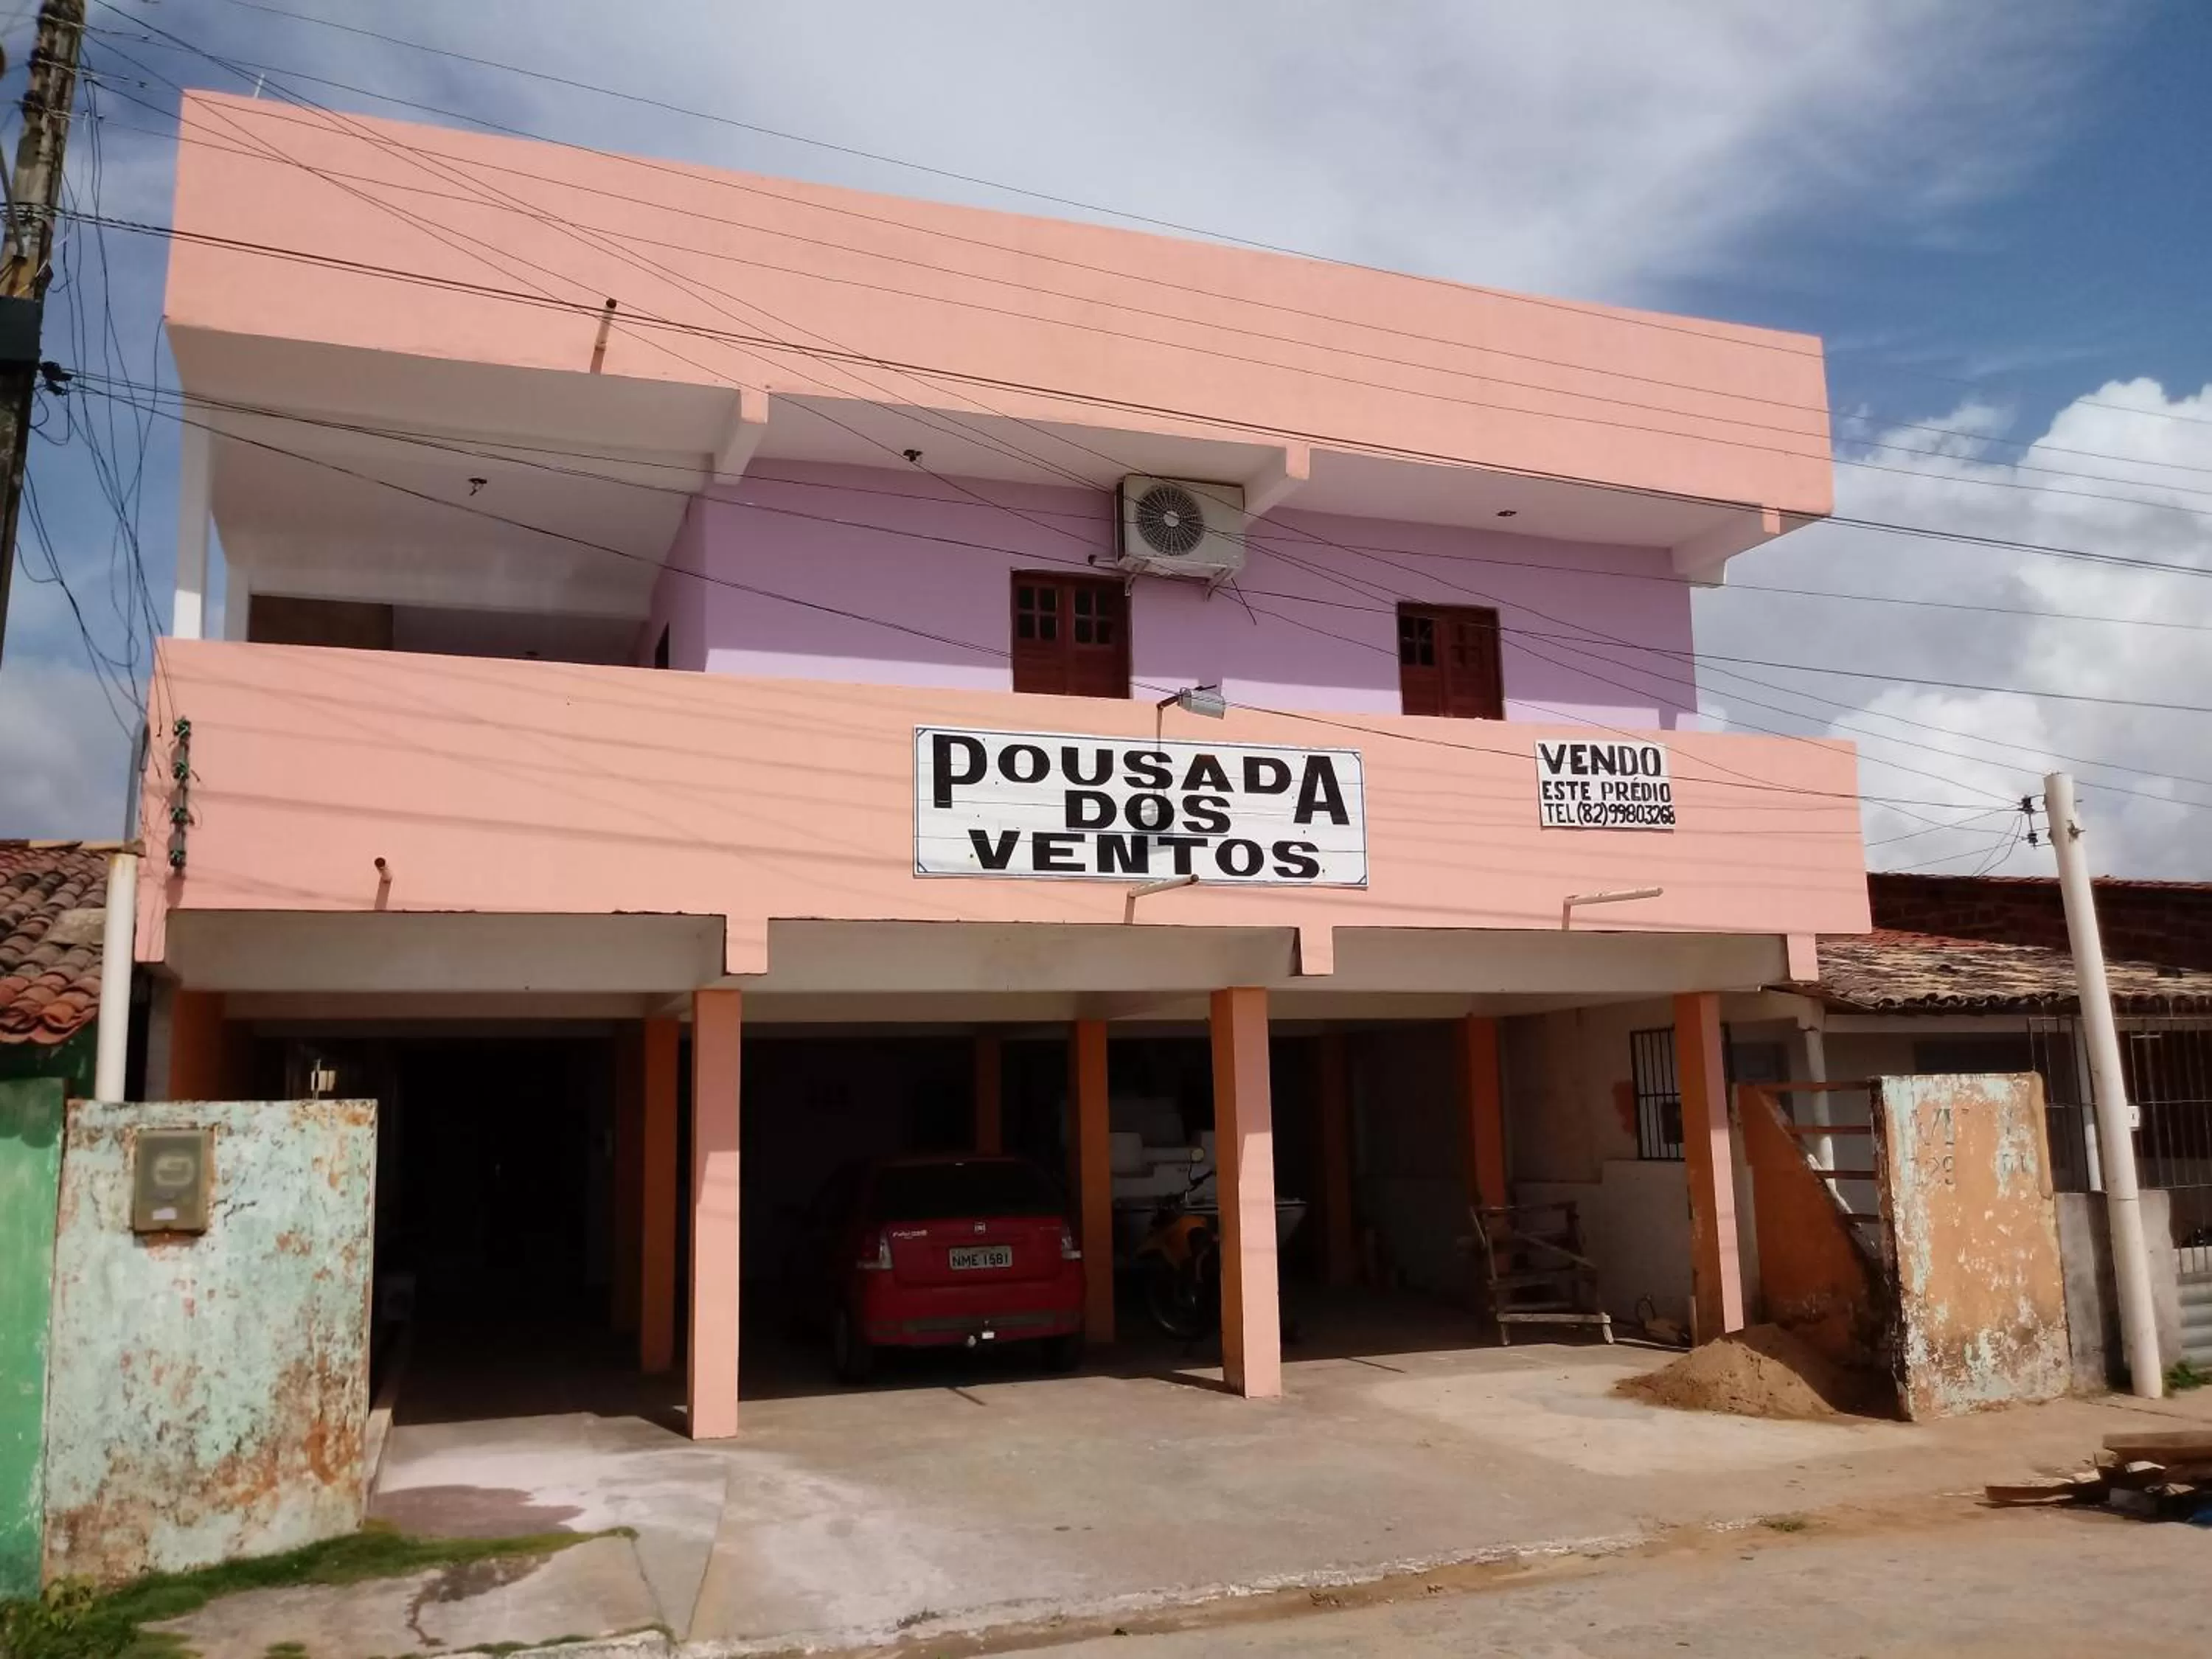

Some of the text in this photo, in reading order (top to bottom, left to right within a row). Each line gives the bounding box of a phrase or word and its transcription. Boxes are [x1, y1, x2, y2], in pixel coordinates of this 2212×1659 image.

[933, 734, 1350, 825] POUSADA
[1538, 743, 1661, 776] VENDO
[1065, 790, 1233, 834] DOS
[1542, 780, 1591, 801] ESTE
[968, 830, 1321, 879] VENTOS
